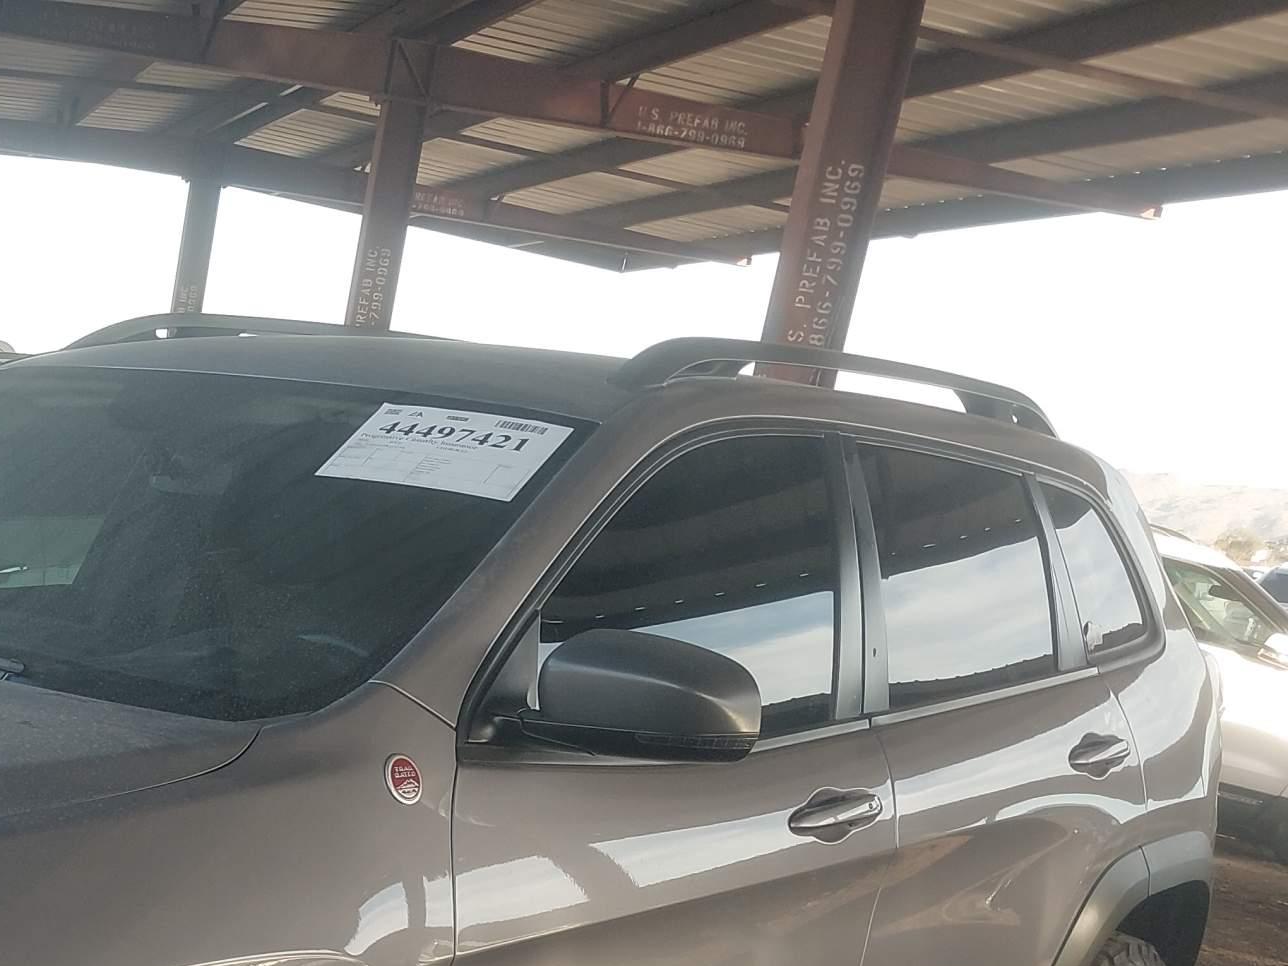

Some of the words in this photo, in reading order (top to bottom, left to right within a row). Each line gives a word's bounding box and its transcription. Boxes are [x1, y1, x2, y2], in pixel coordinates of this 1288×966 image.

[670, 111, 719, 130] PREFAB
[794, 217, 831, 309] PREFAB
[819, 160, 846, 204] INC.
[809, 163, 865, 346] 866-799-0969
[369, 248, 391, 325] -799-0969
[379, 420, 530, 452] 44497421
